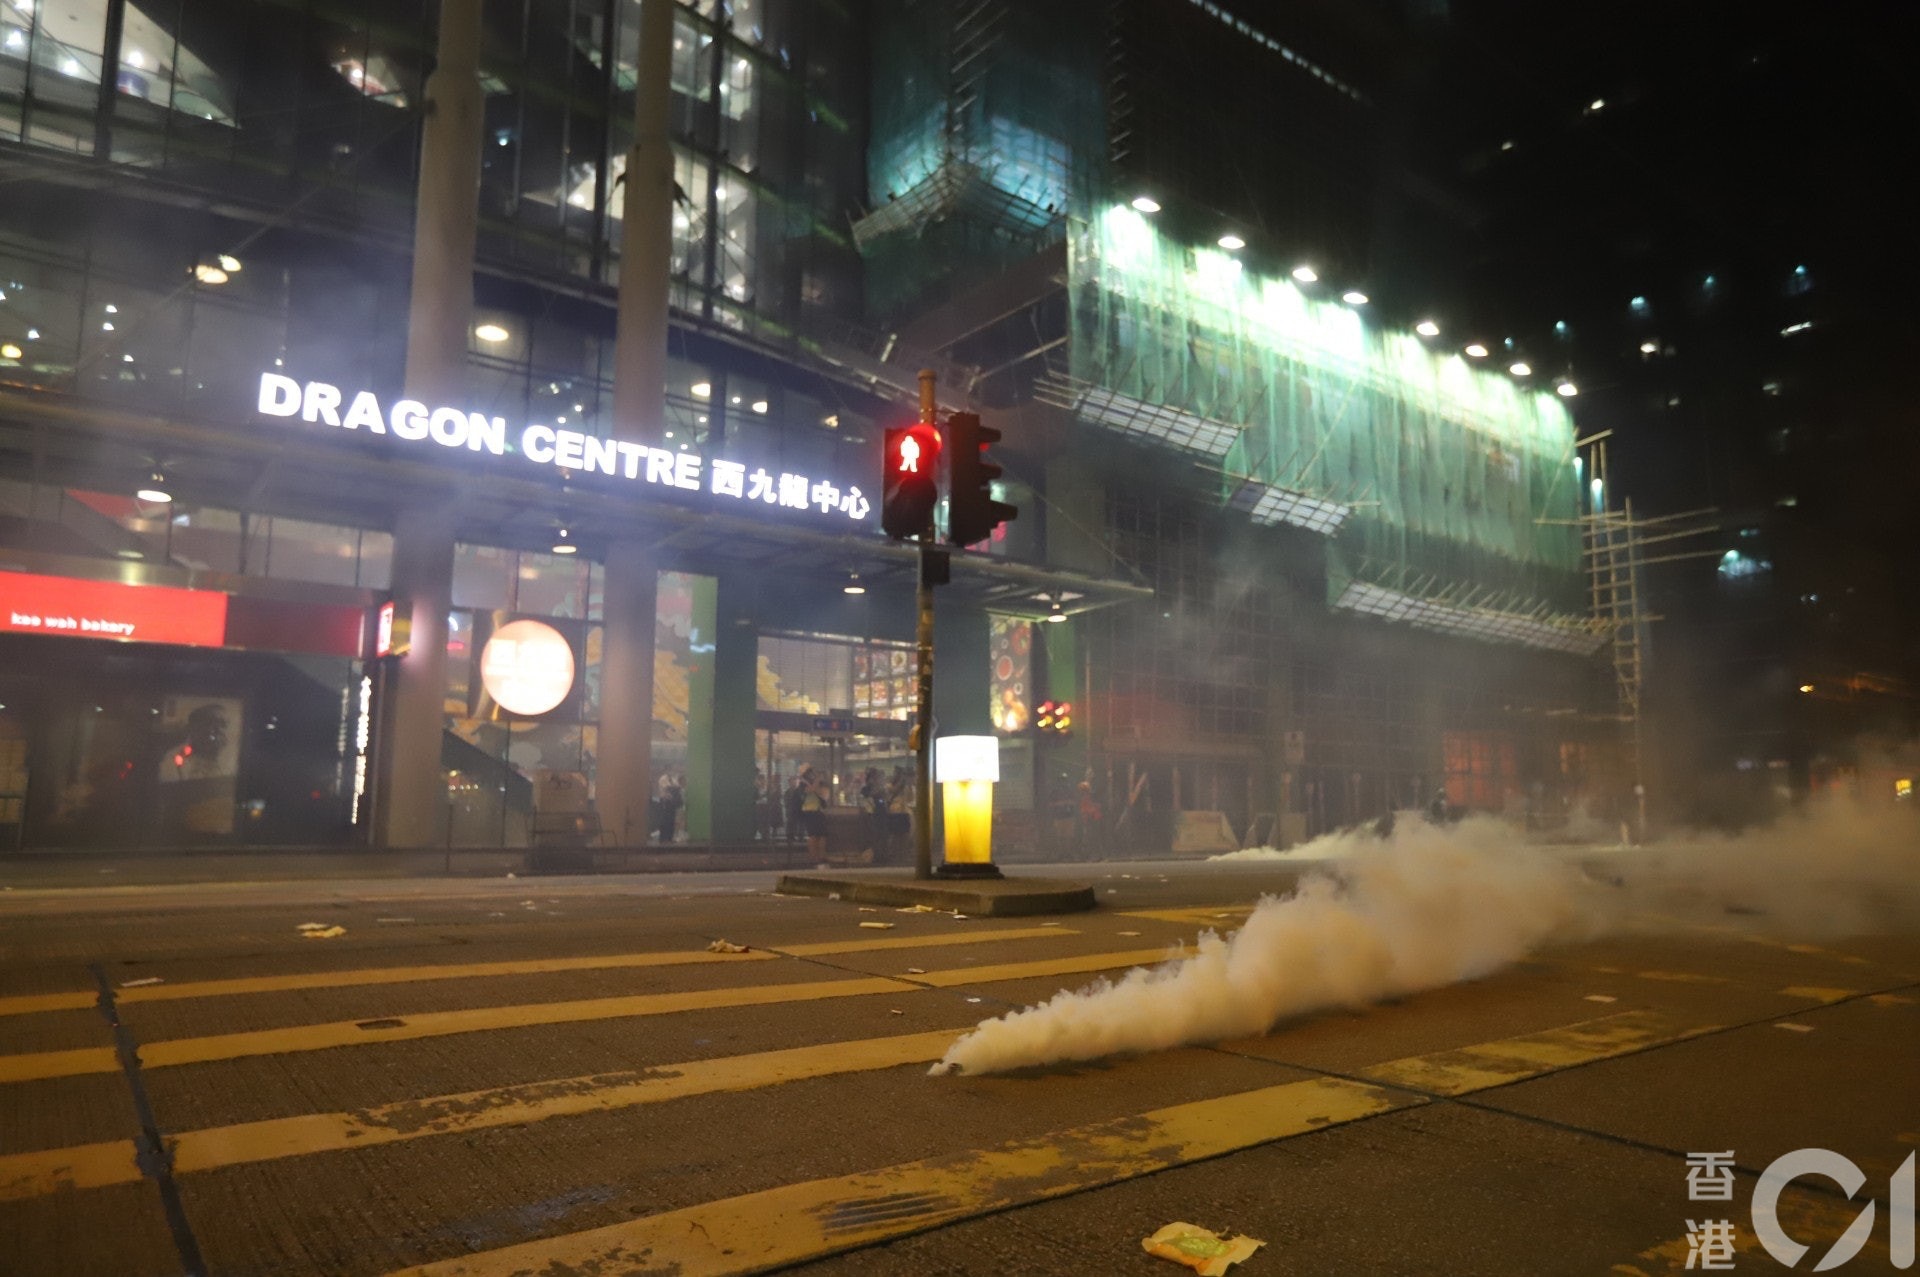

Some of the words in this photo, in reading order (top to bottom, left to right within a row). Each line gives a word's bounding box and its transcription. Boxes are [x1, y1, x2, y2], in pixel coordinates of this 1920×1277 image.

[258, 372, 506, 455] DRAGON
[522, 425, 700, 490] CENTRE
[712, 459, 870, 520] 西九龍中心
[45, 616, 77, 629] wah
[81, 618, 135, 636] bakery
